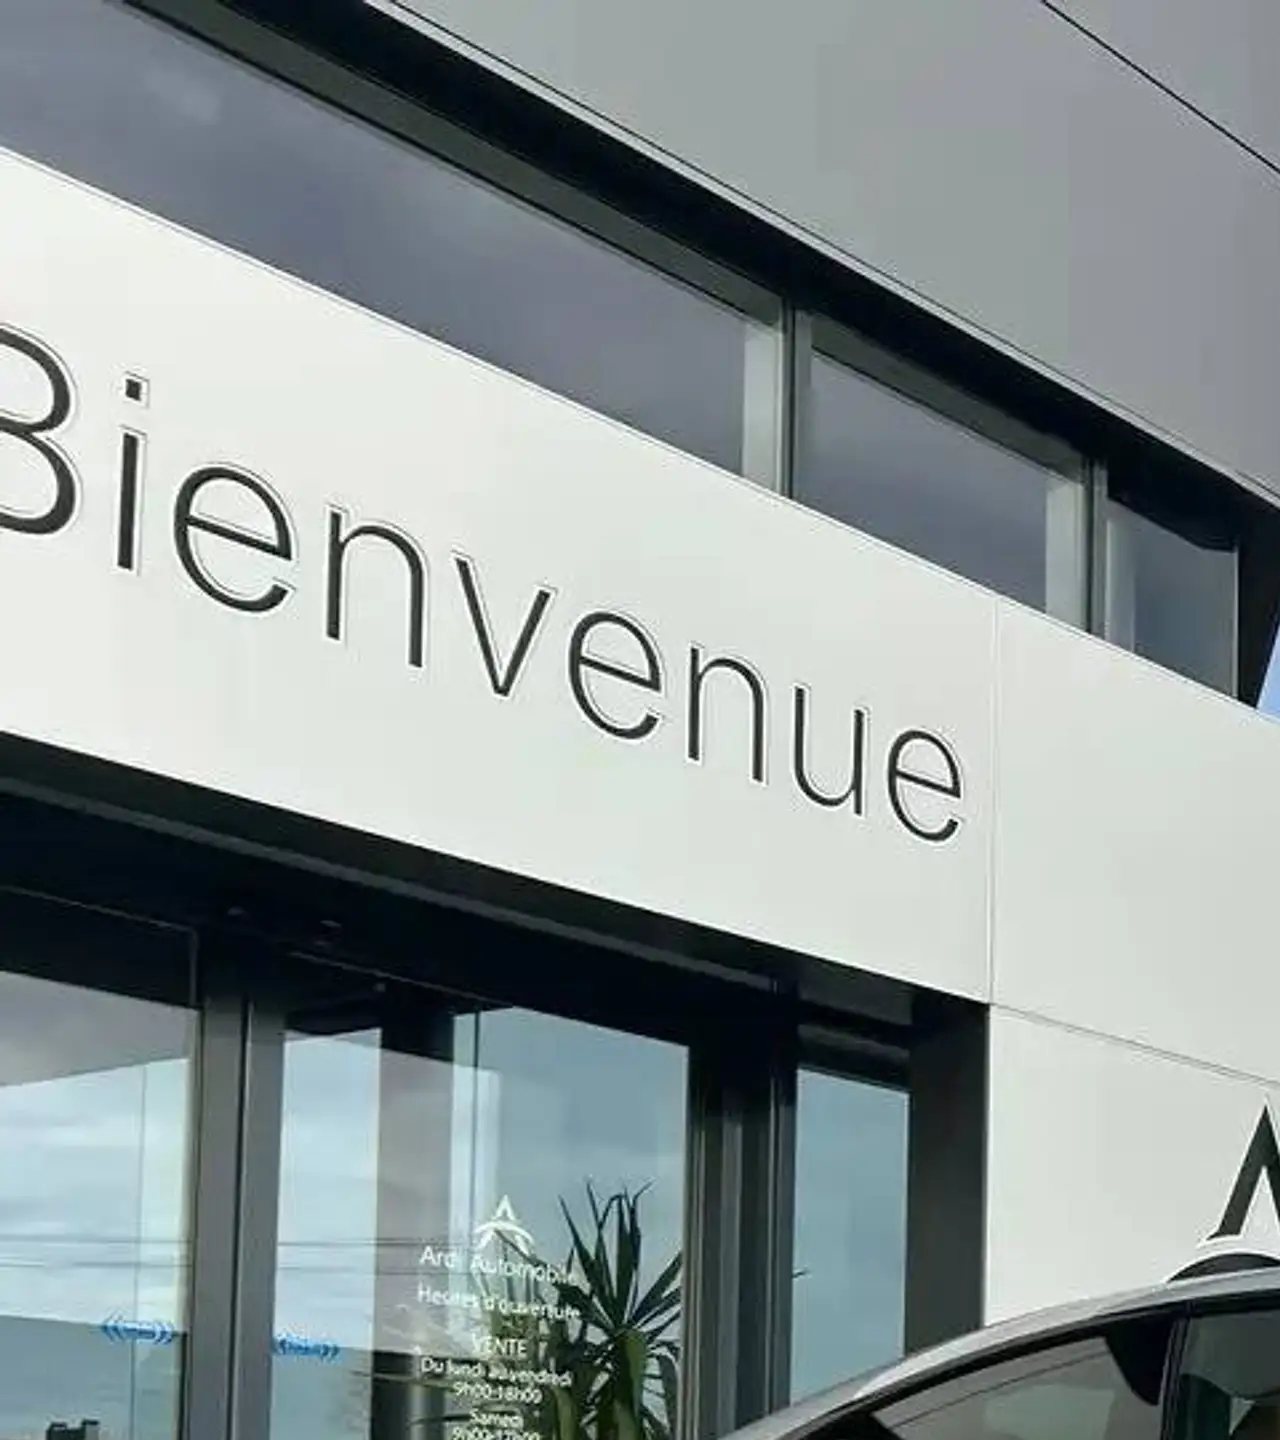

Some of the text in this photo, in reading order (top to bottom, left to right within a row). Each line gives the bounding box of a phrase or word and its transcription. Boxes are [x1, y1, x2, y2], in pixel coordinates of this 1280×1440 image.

[0, 323, 963, 841] Bienvenue
[472, 1334, 527, 1358] VENTE
[421, 1357, 444, 1374] Du
